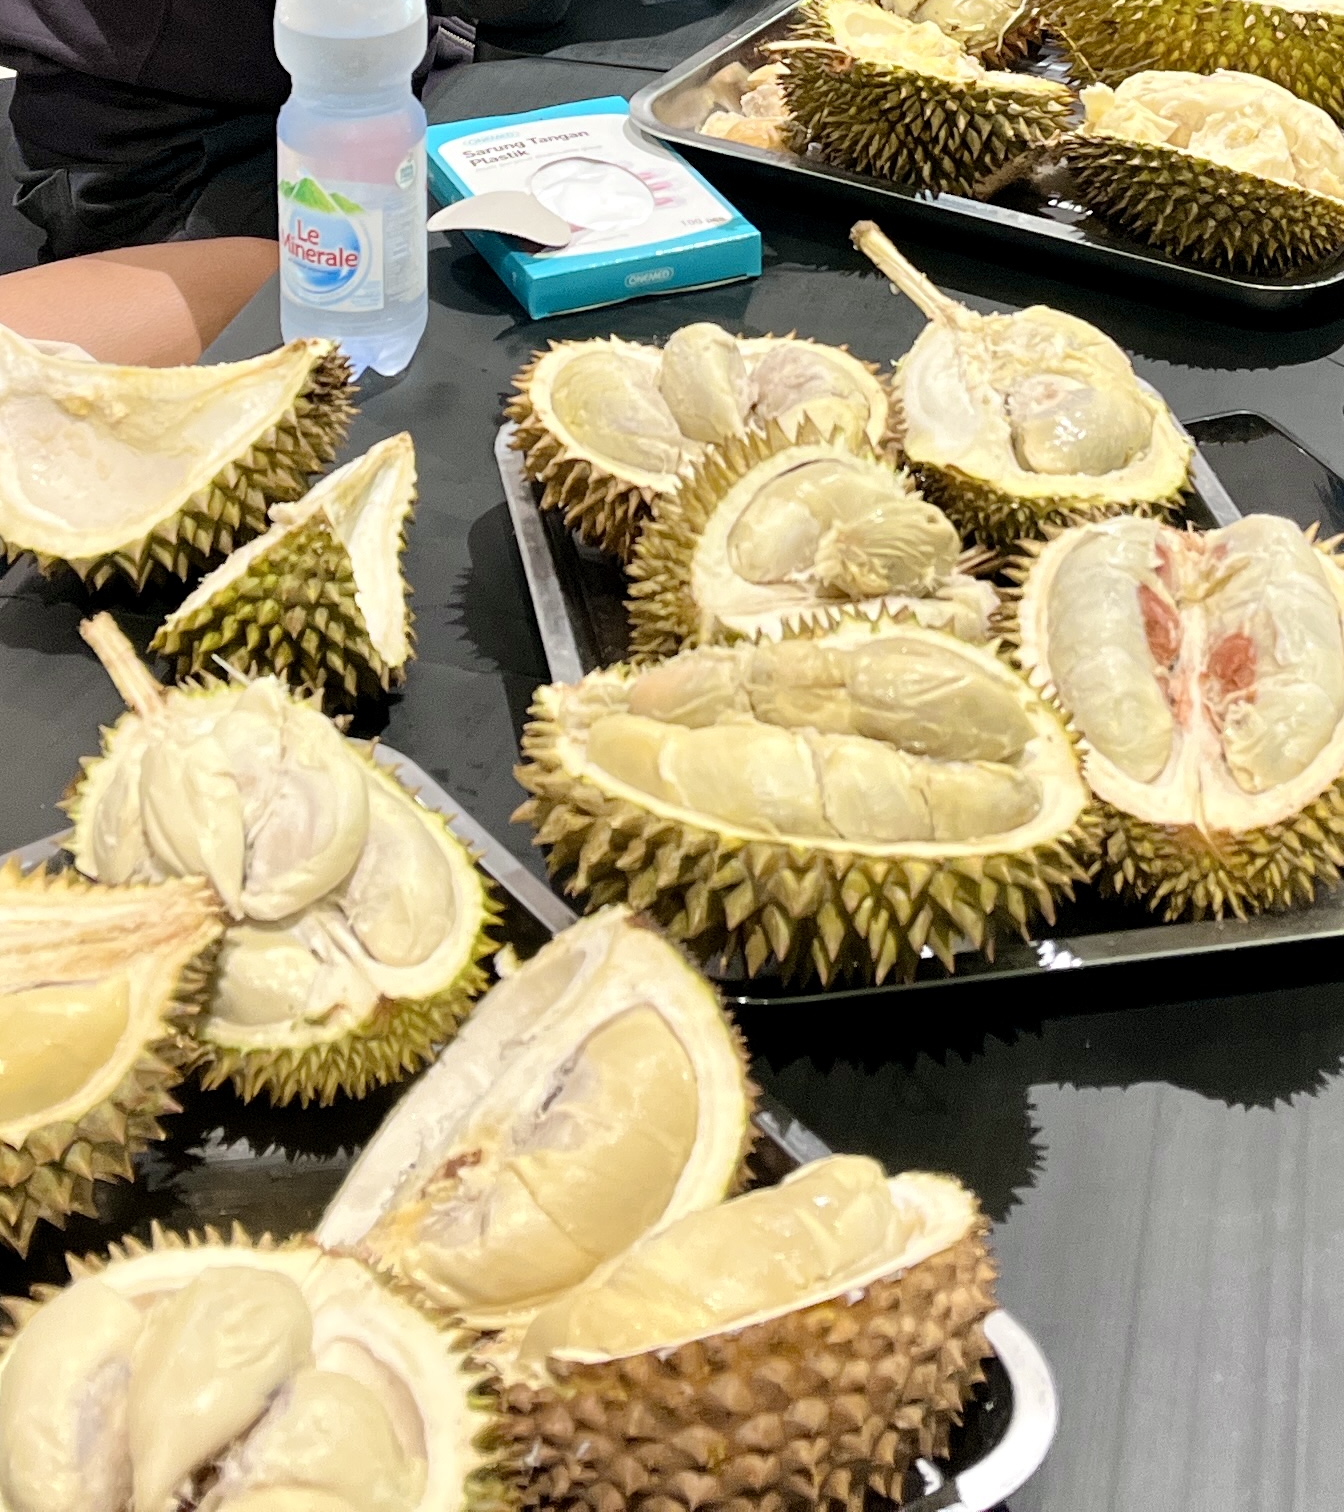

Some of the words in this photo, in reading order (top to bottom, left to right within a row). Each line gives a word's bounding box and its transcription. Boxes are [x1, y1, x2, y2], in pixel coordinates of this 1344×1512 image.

[461, 140, 526, 160] Sarung
[526, 129, 590, 149] Tangan
[468, 150, 530, 168] Plastik
[297, 219, 320, 246] Le
